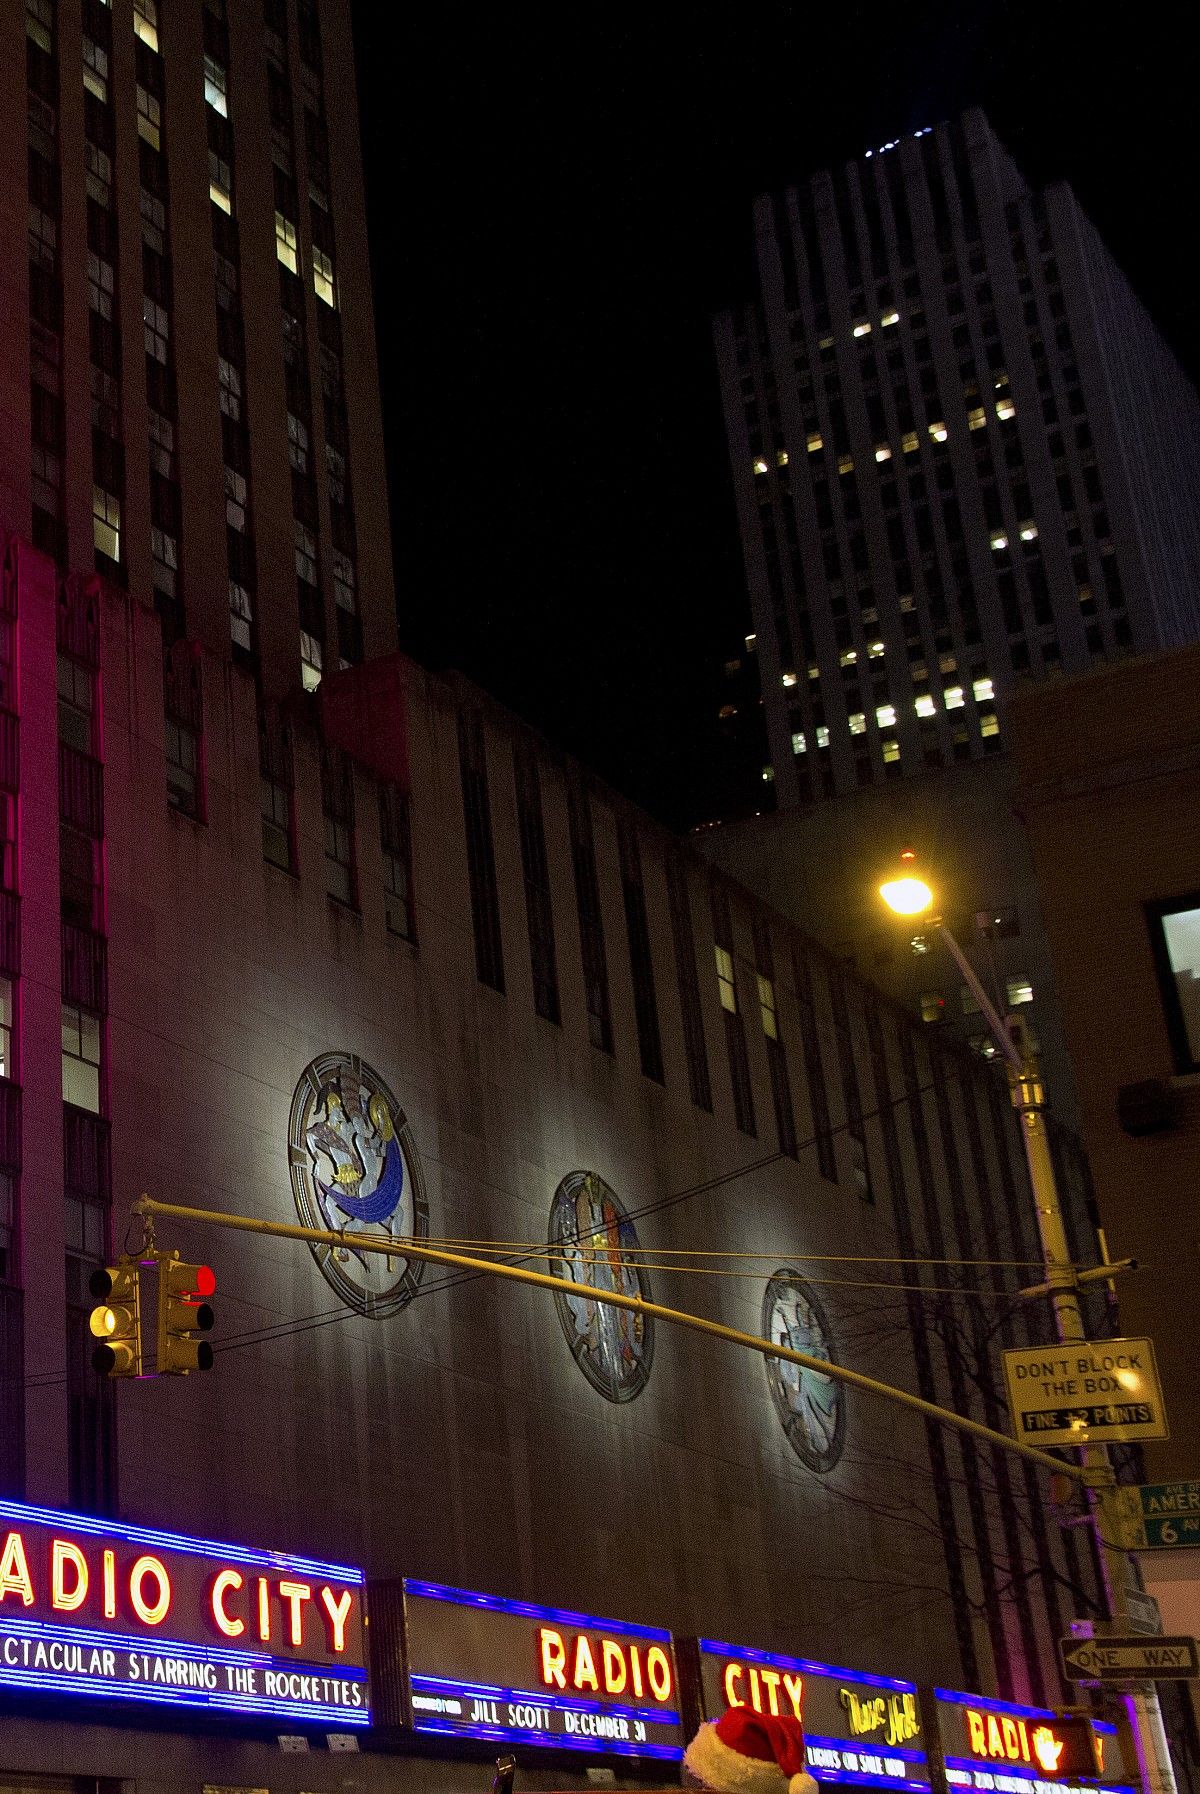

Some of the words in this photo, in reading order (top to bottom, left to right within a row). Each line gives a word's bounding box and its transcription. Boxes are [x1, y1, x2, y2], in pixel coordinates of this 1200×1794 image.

[1015, 1360, 1068, 1379] DON'T
[1078, 1354, 1143, 1373] BLOCK
[1041, 1380, 1076, 1397] THE
[1085, 1377, 1123, 1393] BOX
[1026, 1412, 1060, 1429] FINE
[1094, 1405, 1149, 1424] POINTS
[1161, 1520, 1179, 1543] 6
[211, 1568, 353, 1652] CITY
[1076, 1650, 1120, 1667] ONE
[1143, 1649, 1185, 1666] WAY
[129, 1653, 217, 1689] STARRING
[226, 1666, 256, 1694] THE
[265, 1672, 361, 1707] ROCKETTES
[540, 1628, 672, 1702] RADIO
[725, 1664, 803, 1722] CITY
[470, 1699, 501, 1724] JILL
[508, 1705, 550, 1730] SCOTT
[564, 1712, 629, 1741] DECEMBER
[967, 1710, 1031, 1762] RADI
